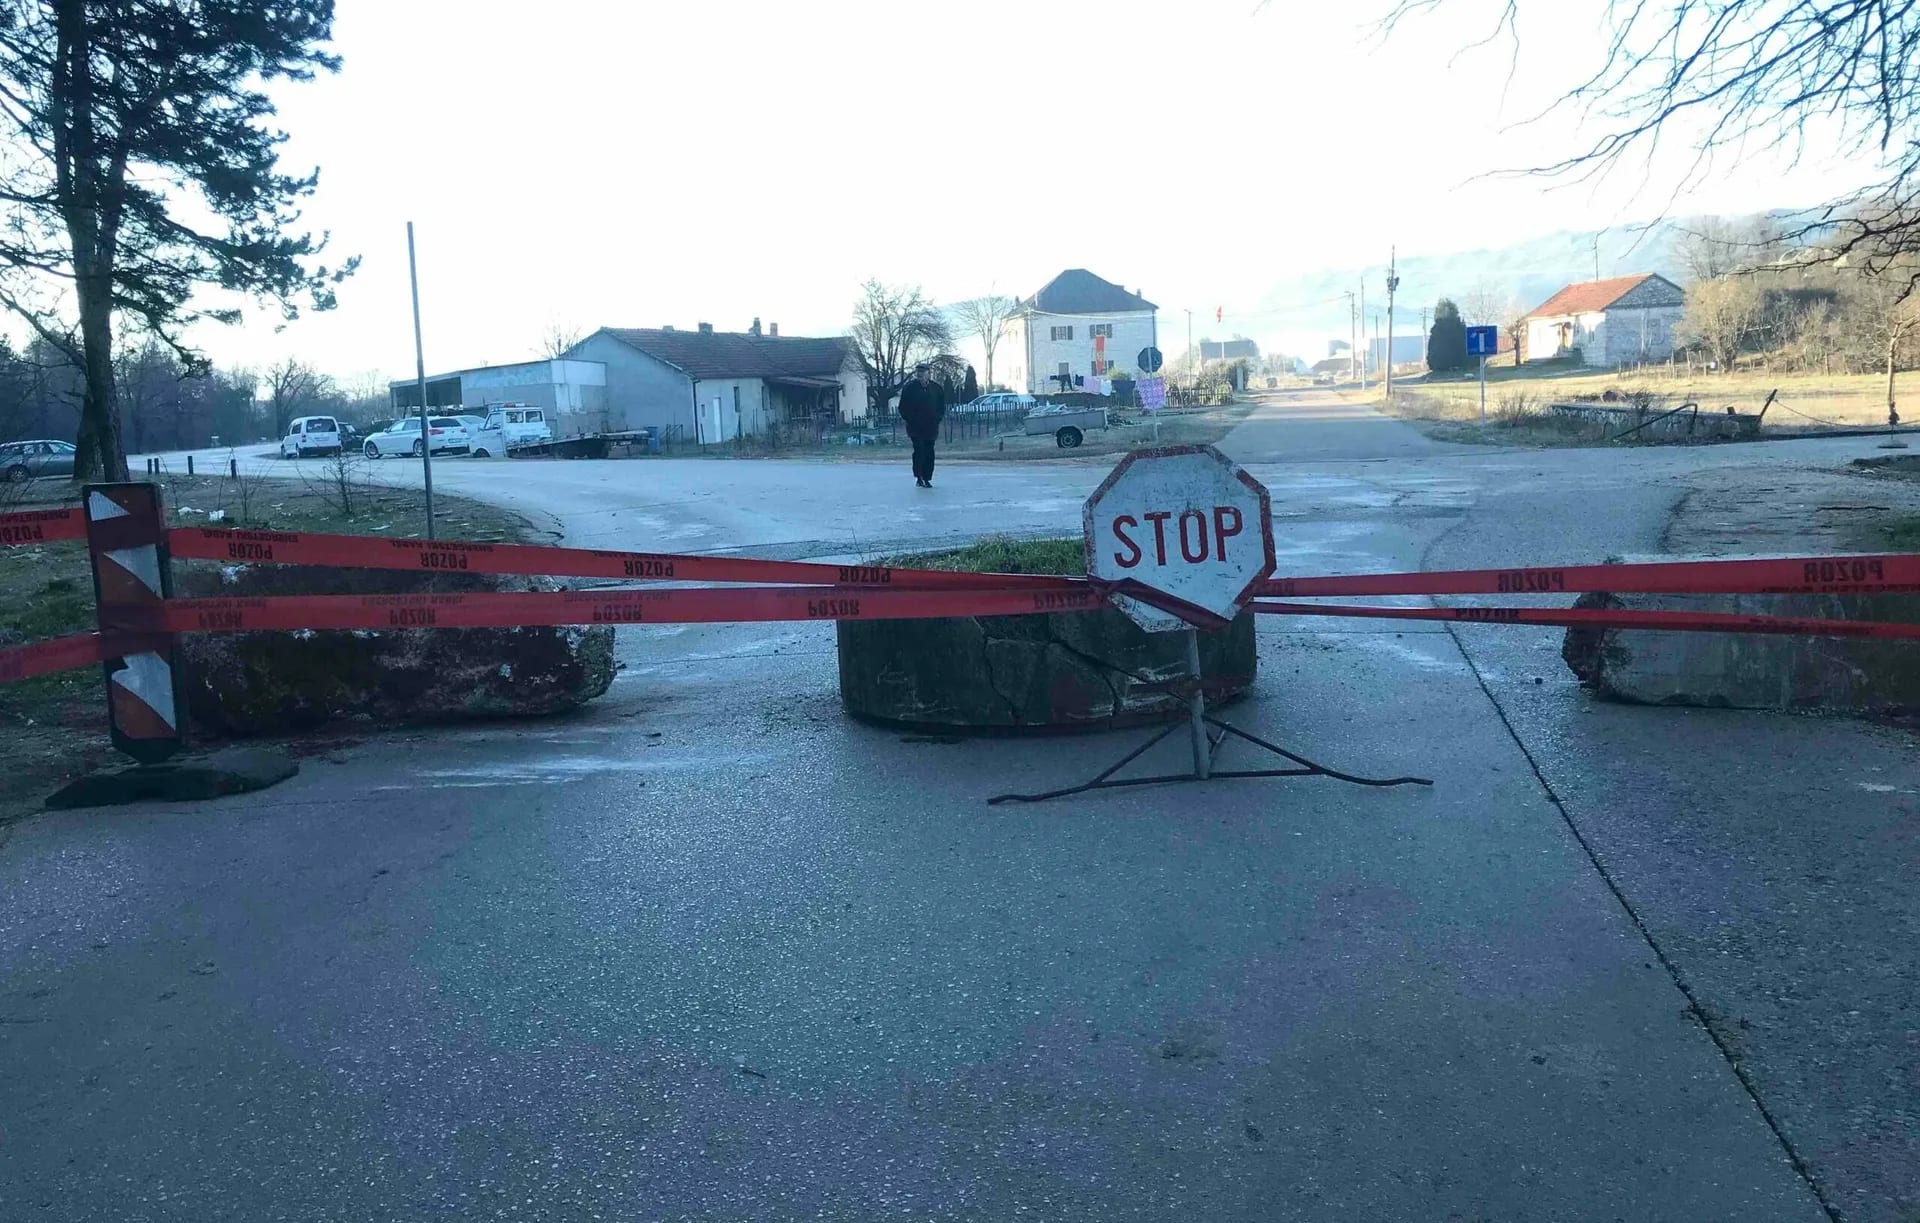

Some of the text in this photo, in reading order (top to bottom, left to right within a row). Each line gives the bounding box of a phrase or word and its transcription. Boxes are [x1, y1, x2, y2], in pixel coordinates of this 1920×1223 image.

[0, 525, 43, 543] POZO
[1112, 505, 1244, 569] STOP
[227, 543, 273, 560] POZOR
[420, 552, 468, 570] POZOR
[623, 560, 674, 577] POZOR
[839, 567, 891, 584] POZOR
